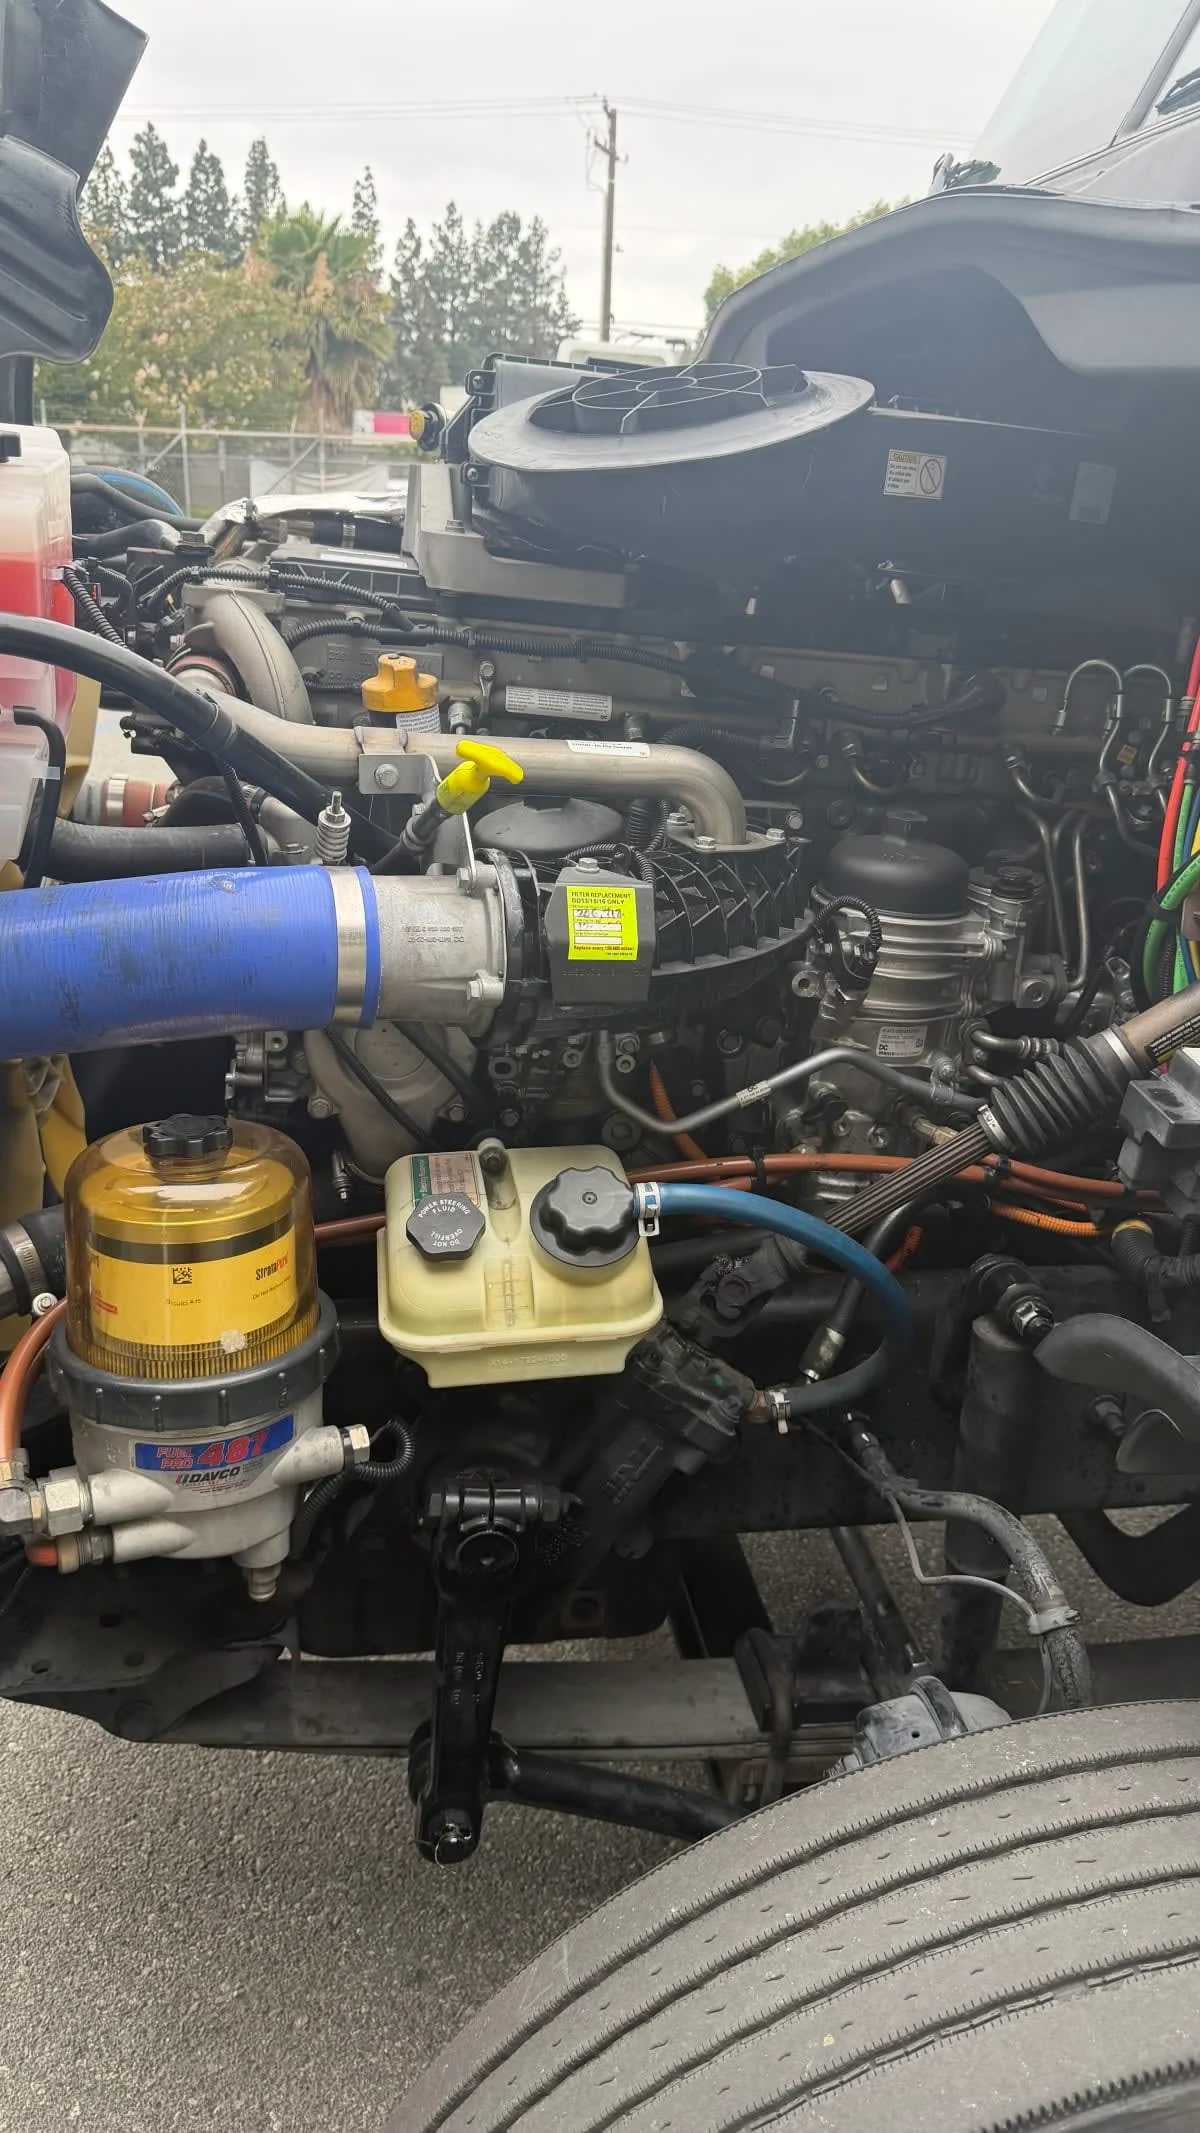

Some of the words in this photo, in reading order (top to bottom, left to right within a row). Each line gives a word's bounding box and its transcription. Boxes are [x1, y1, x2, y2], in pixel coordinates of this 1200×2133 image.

[418, 1201, 439, 1219] POWER
[440, 1200, 471, 1215] STEERING
[432, 1205, 456, 1214] FLUID
[431, 1228, 463, 1240] OVERFILL
[449, 1238, 460, 1246] DO
[156, 1446, 194, 1458] FUEL
[197, 1427, 270, 1467] 487
[160, 1457, 193, 1470] PRO
[188, 1466, 241, 1484] DAVCO
